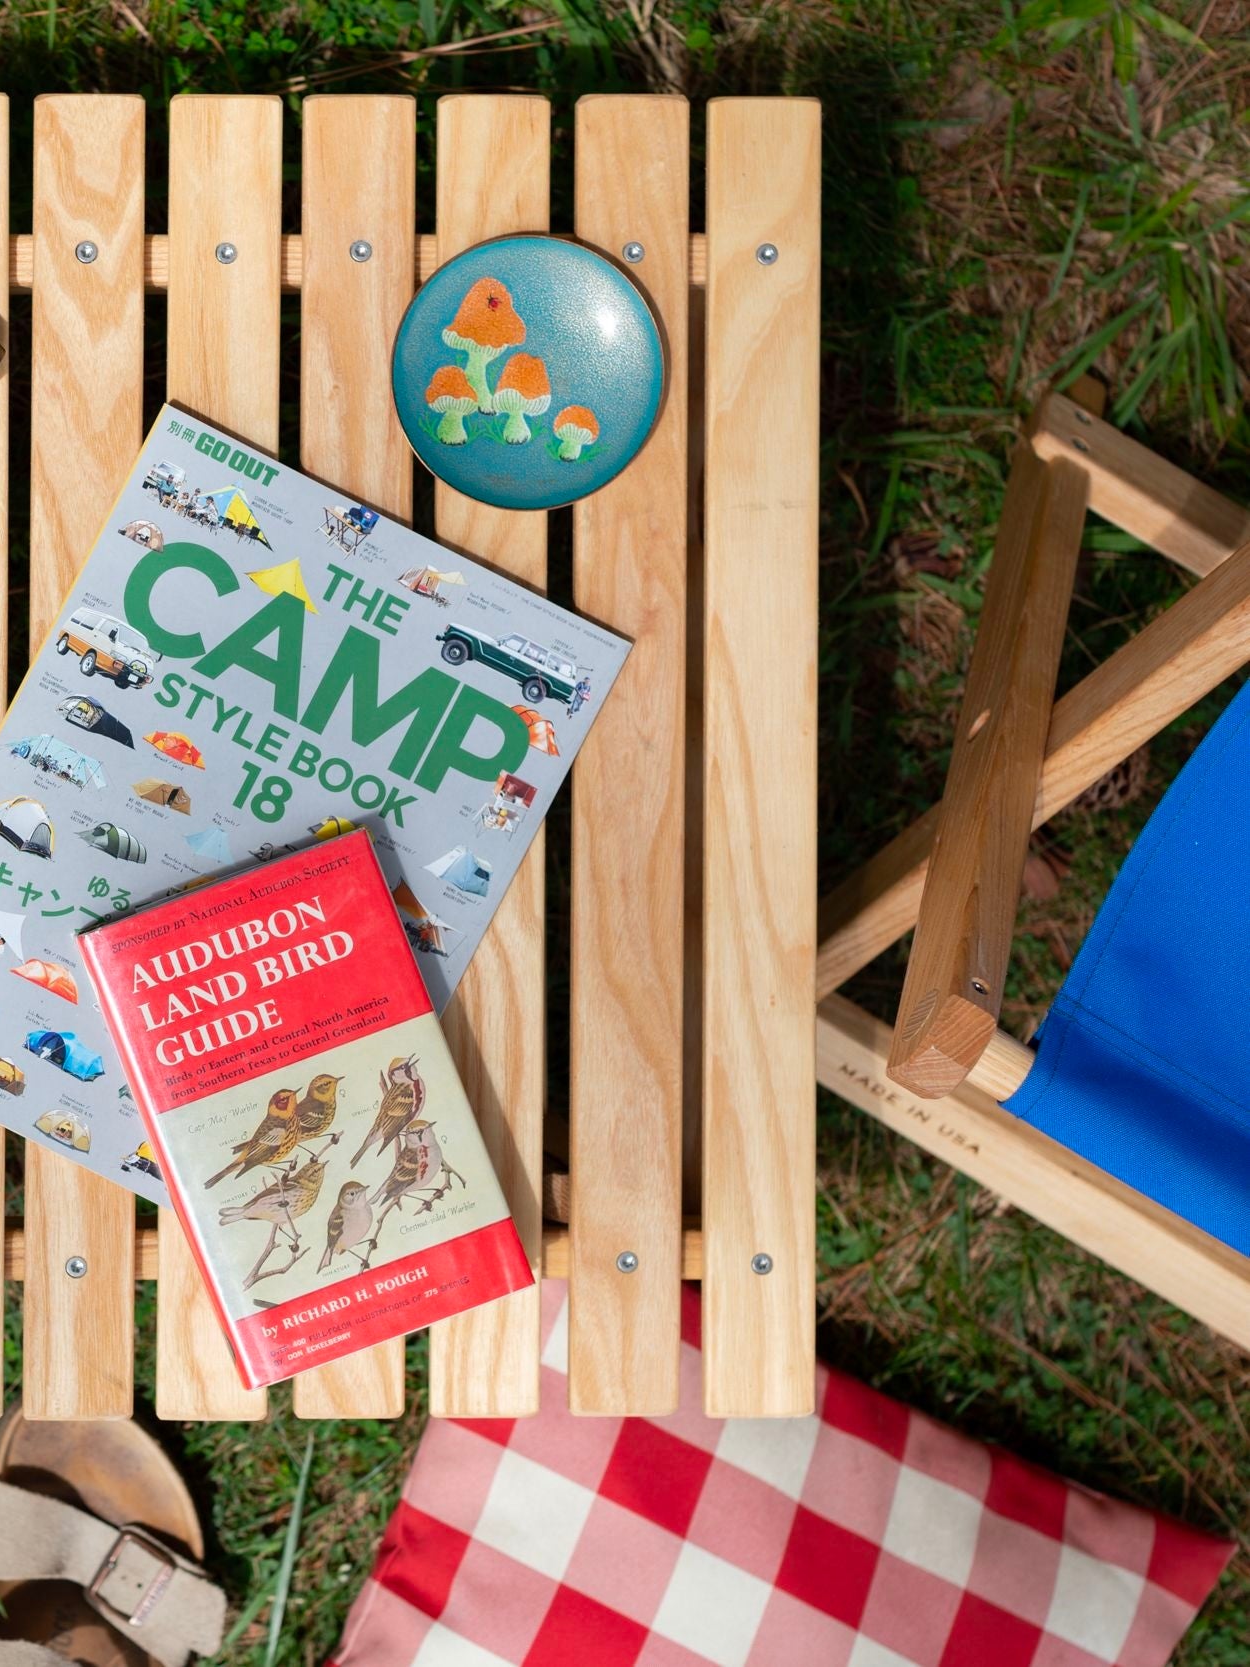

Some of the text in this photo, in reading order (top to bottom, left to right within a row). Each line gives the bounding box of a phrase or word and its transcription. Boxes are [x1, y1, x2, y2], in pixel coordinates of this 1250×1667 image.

[166, 420, 194, 443] 別冊
[194, 432, 279, 487] GO OUT
[324, 564, 411, 635] THE
[123, 542, 530, 794] CAMP
[154, 673, 419, 829] STYLE BOOK
[233, 761, 294, 824] 18
[87, 875, 131, 911] ゆる
[110, 923, 171, 954] SPONSORED
[171, 917, 188, 930] BY
[131, 896, 327, 996] AUDUBON
[136, 931, 355, 1033] LAND BIRD
[155, 999, 284, 1067] GUIDE
[164, 993, 389, 1087] Birds of Eastern and Central North America
[169, 1010, 385, 1101] from Southern Texas to Central Greenland
[838, 1062, 980, 1155] MADE IN USA
[261, 1265, 429, 1340] by RICHARD H. POUGH
[287, 1349, 303, 1361] DON
[305, 1330, 352, 1354] ECKELBERRY
